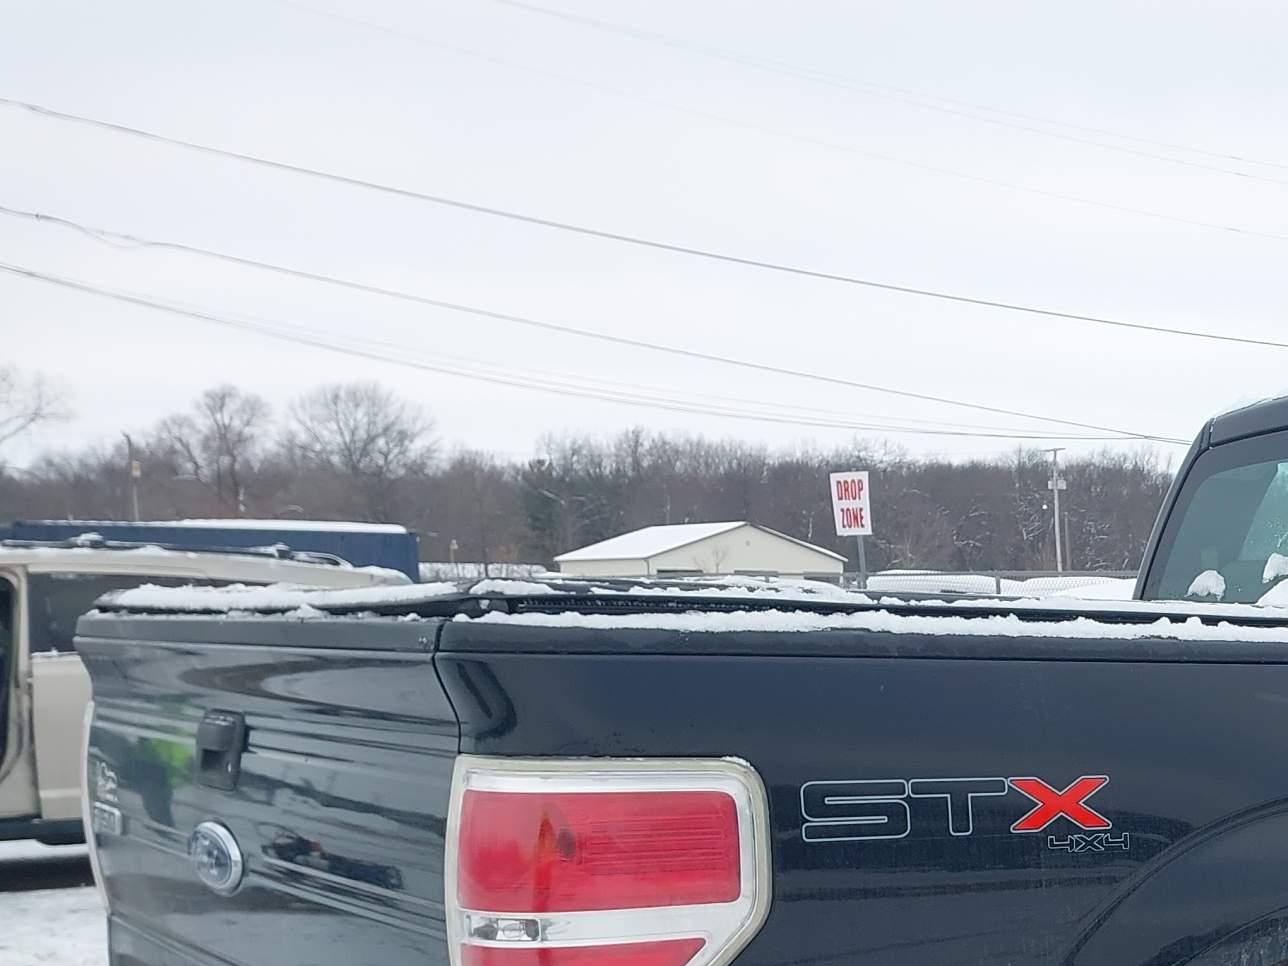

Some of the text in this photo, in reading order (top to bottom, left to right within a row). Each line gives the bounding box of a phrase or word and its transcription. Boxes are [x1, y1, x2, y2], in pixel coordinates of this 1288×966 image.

[836, 479, 864, 501] DROP
[840, 507, 865, 528] ZONE
[801, 776, 1112, 842] STX
